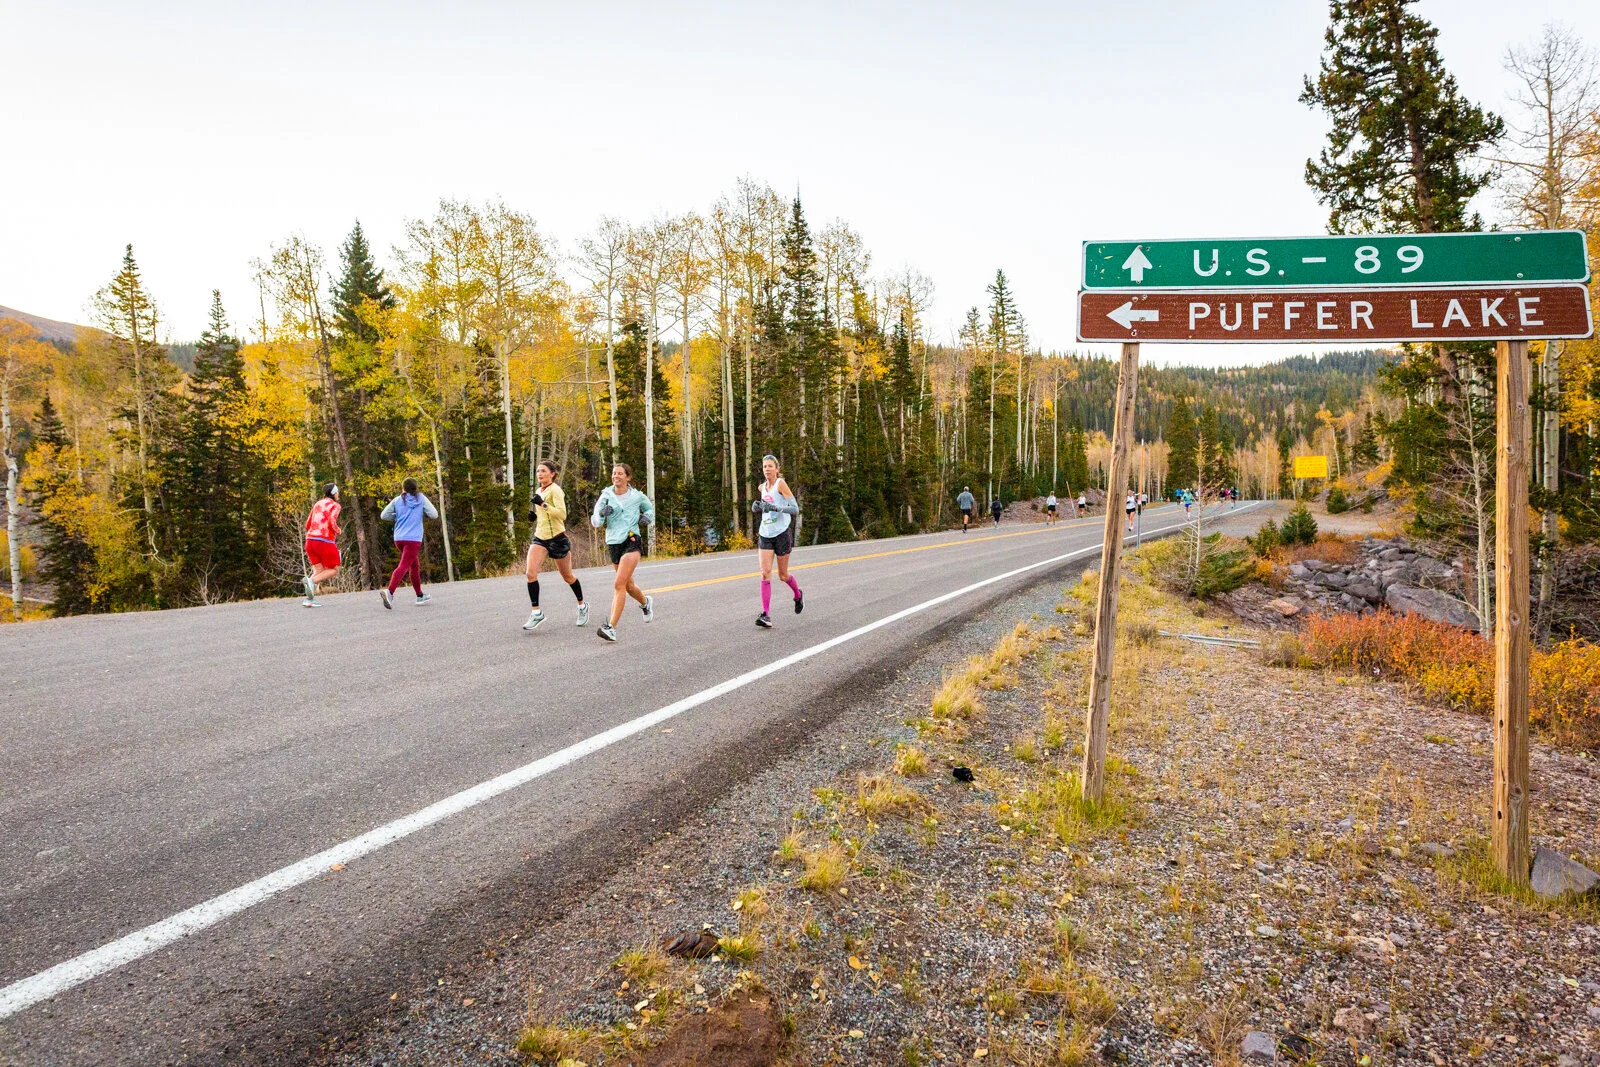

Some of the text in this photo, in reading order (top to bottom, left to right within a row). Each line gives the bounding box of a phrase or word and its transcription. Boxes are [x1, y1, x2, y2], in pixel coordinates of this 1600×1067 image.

[1354, 245, 1424, 274] 89
[1188, 296, 1544, 331] PUFFER LAKE
